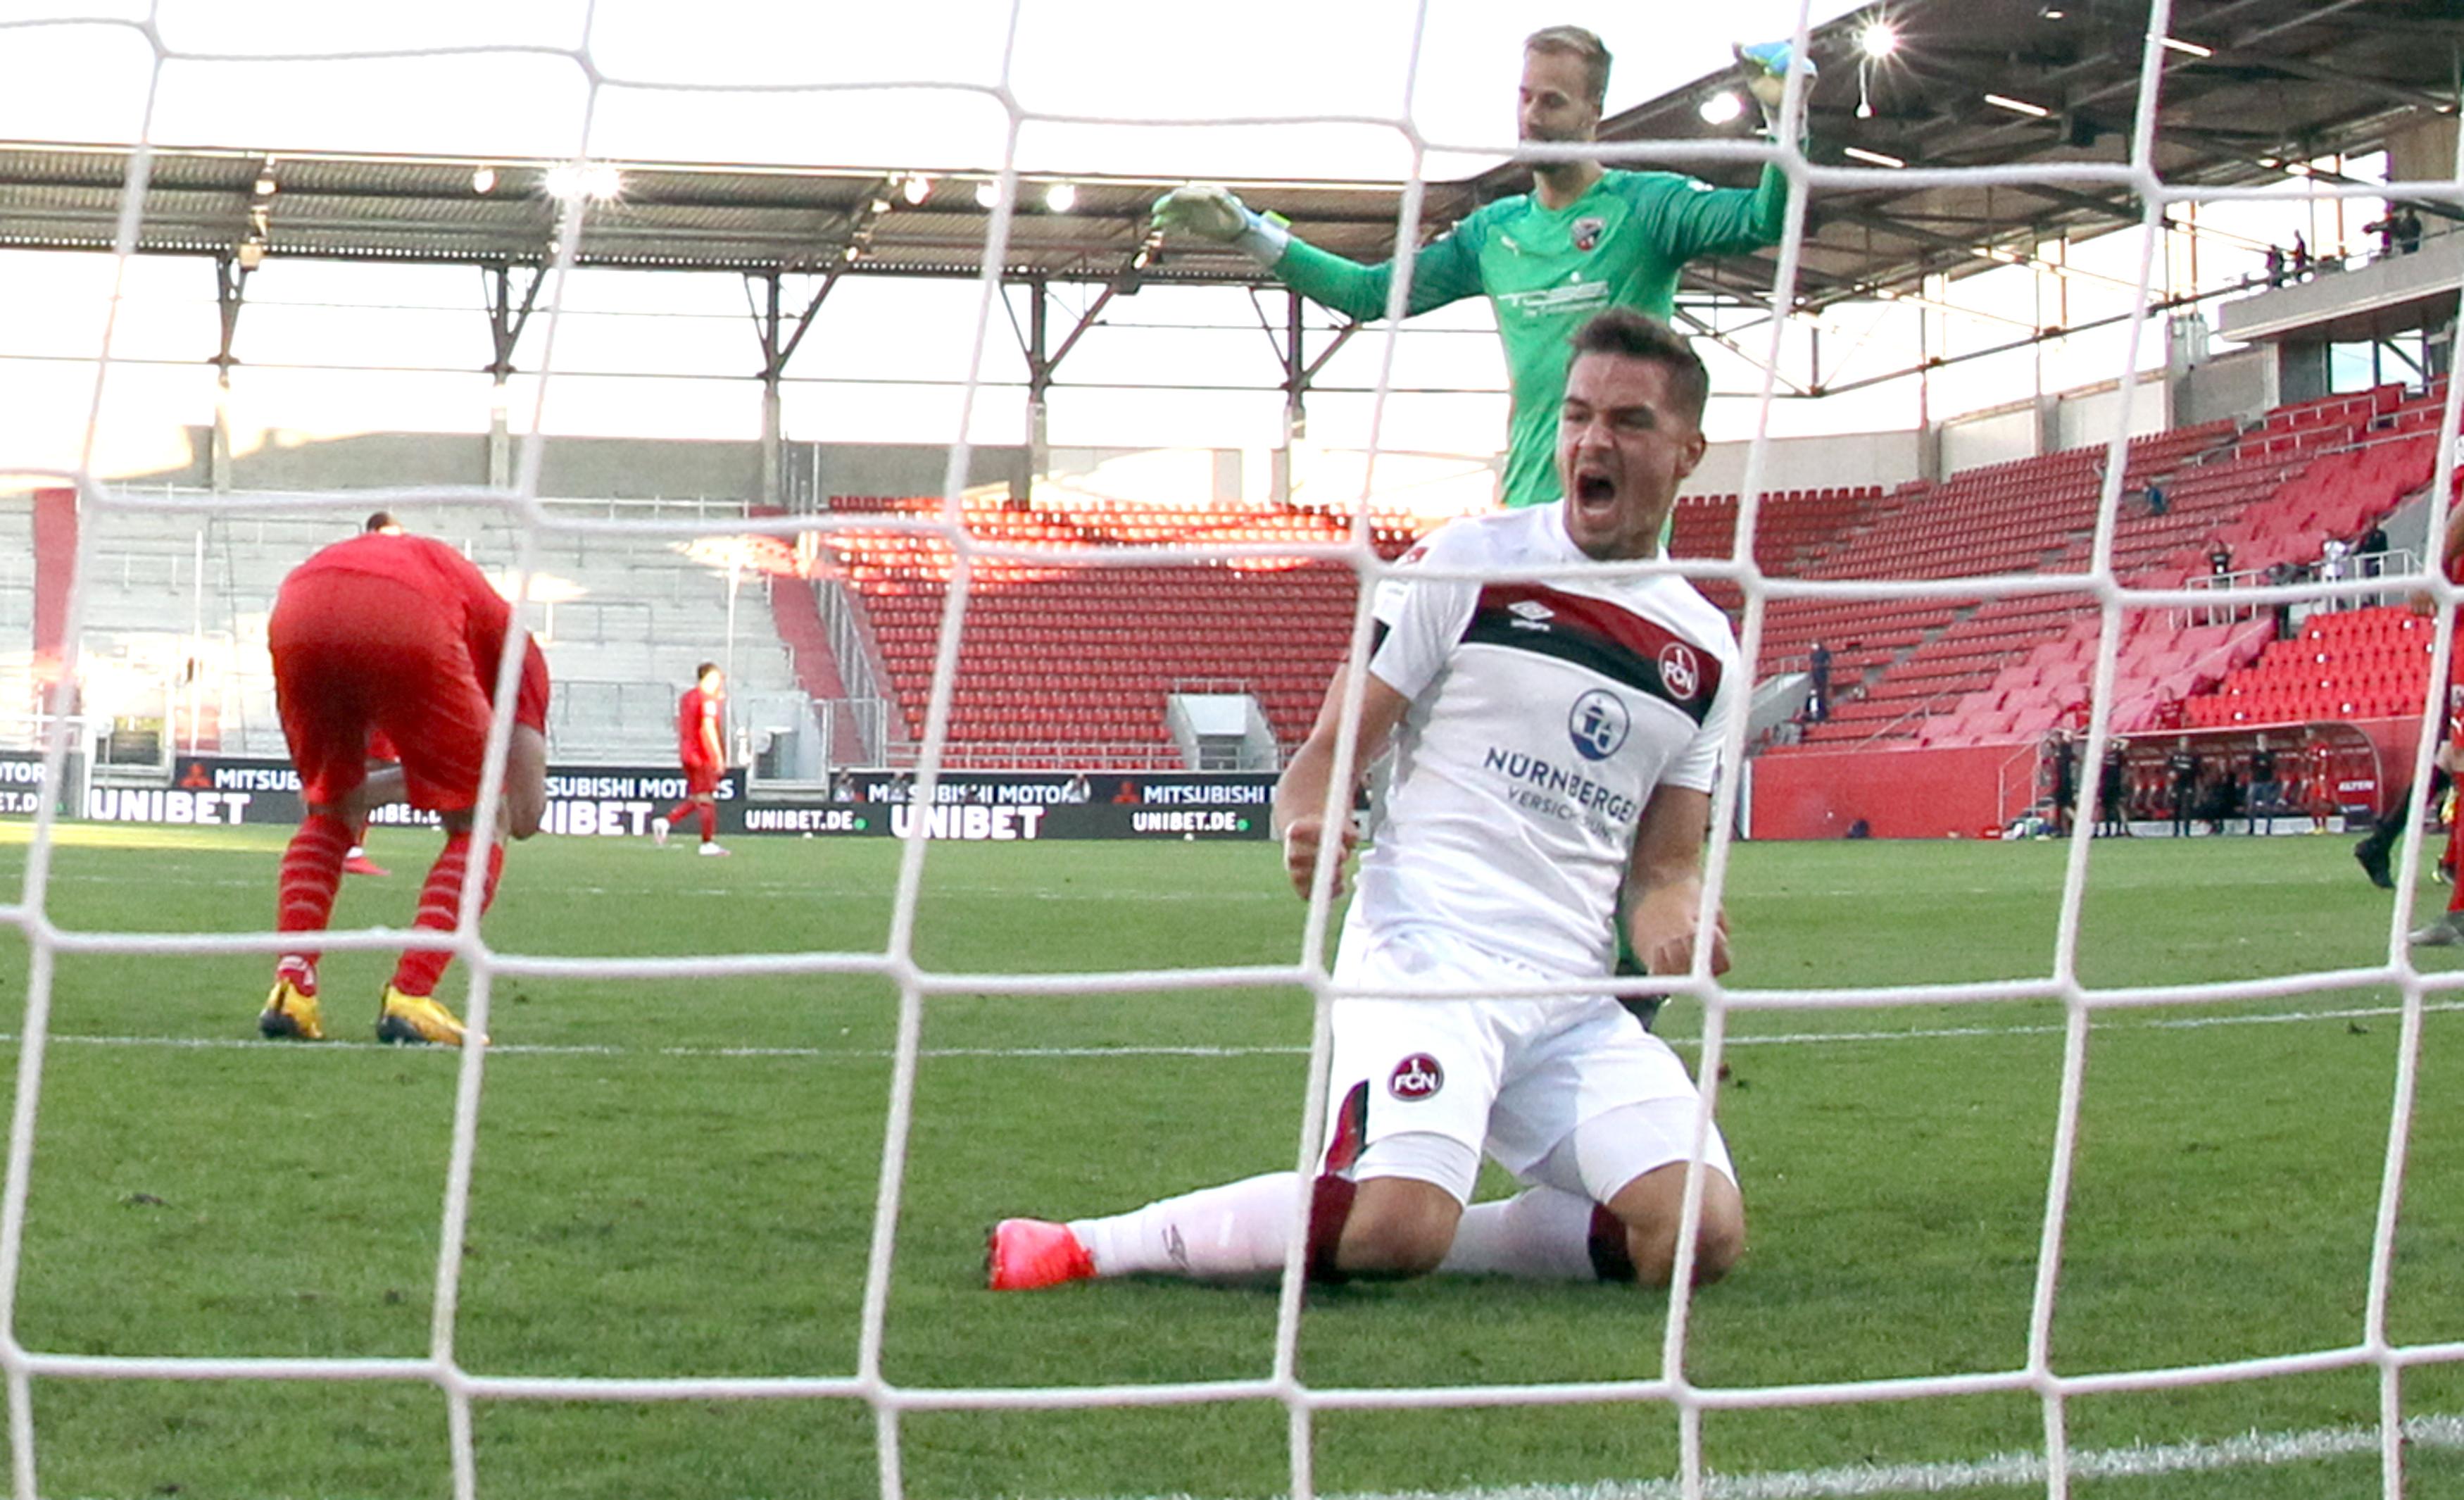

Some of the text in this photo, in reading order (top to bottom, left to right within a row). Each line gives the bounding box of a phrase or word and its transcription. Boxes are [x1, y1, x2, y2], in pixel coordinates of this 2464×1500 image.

[0, 762, 48, 782] TOR
[215, 768, 301, 789] MITSUB
[545, 777, 734, 799] SUBISHI MOTS
[868, 784, 1074, 804] MSBIHI MOTO
[1143, 785, 1264, 804] MITSUBISHI
[90, 788, 251, 824] UNIBET
[539, 800, 653, 836] IBET
[746, 810, 855, 830] UNIBET.DE
[890, 805, 1045, 839] UNIBET
[1132, 812, 1237, 831] UNIBET.DE
[1395, 1072, 1435, 1091] FCN
